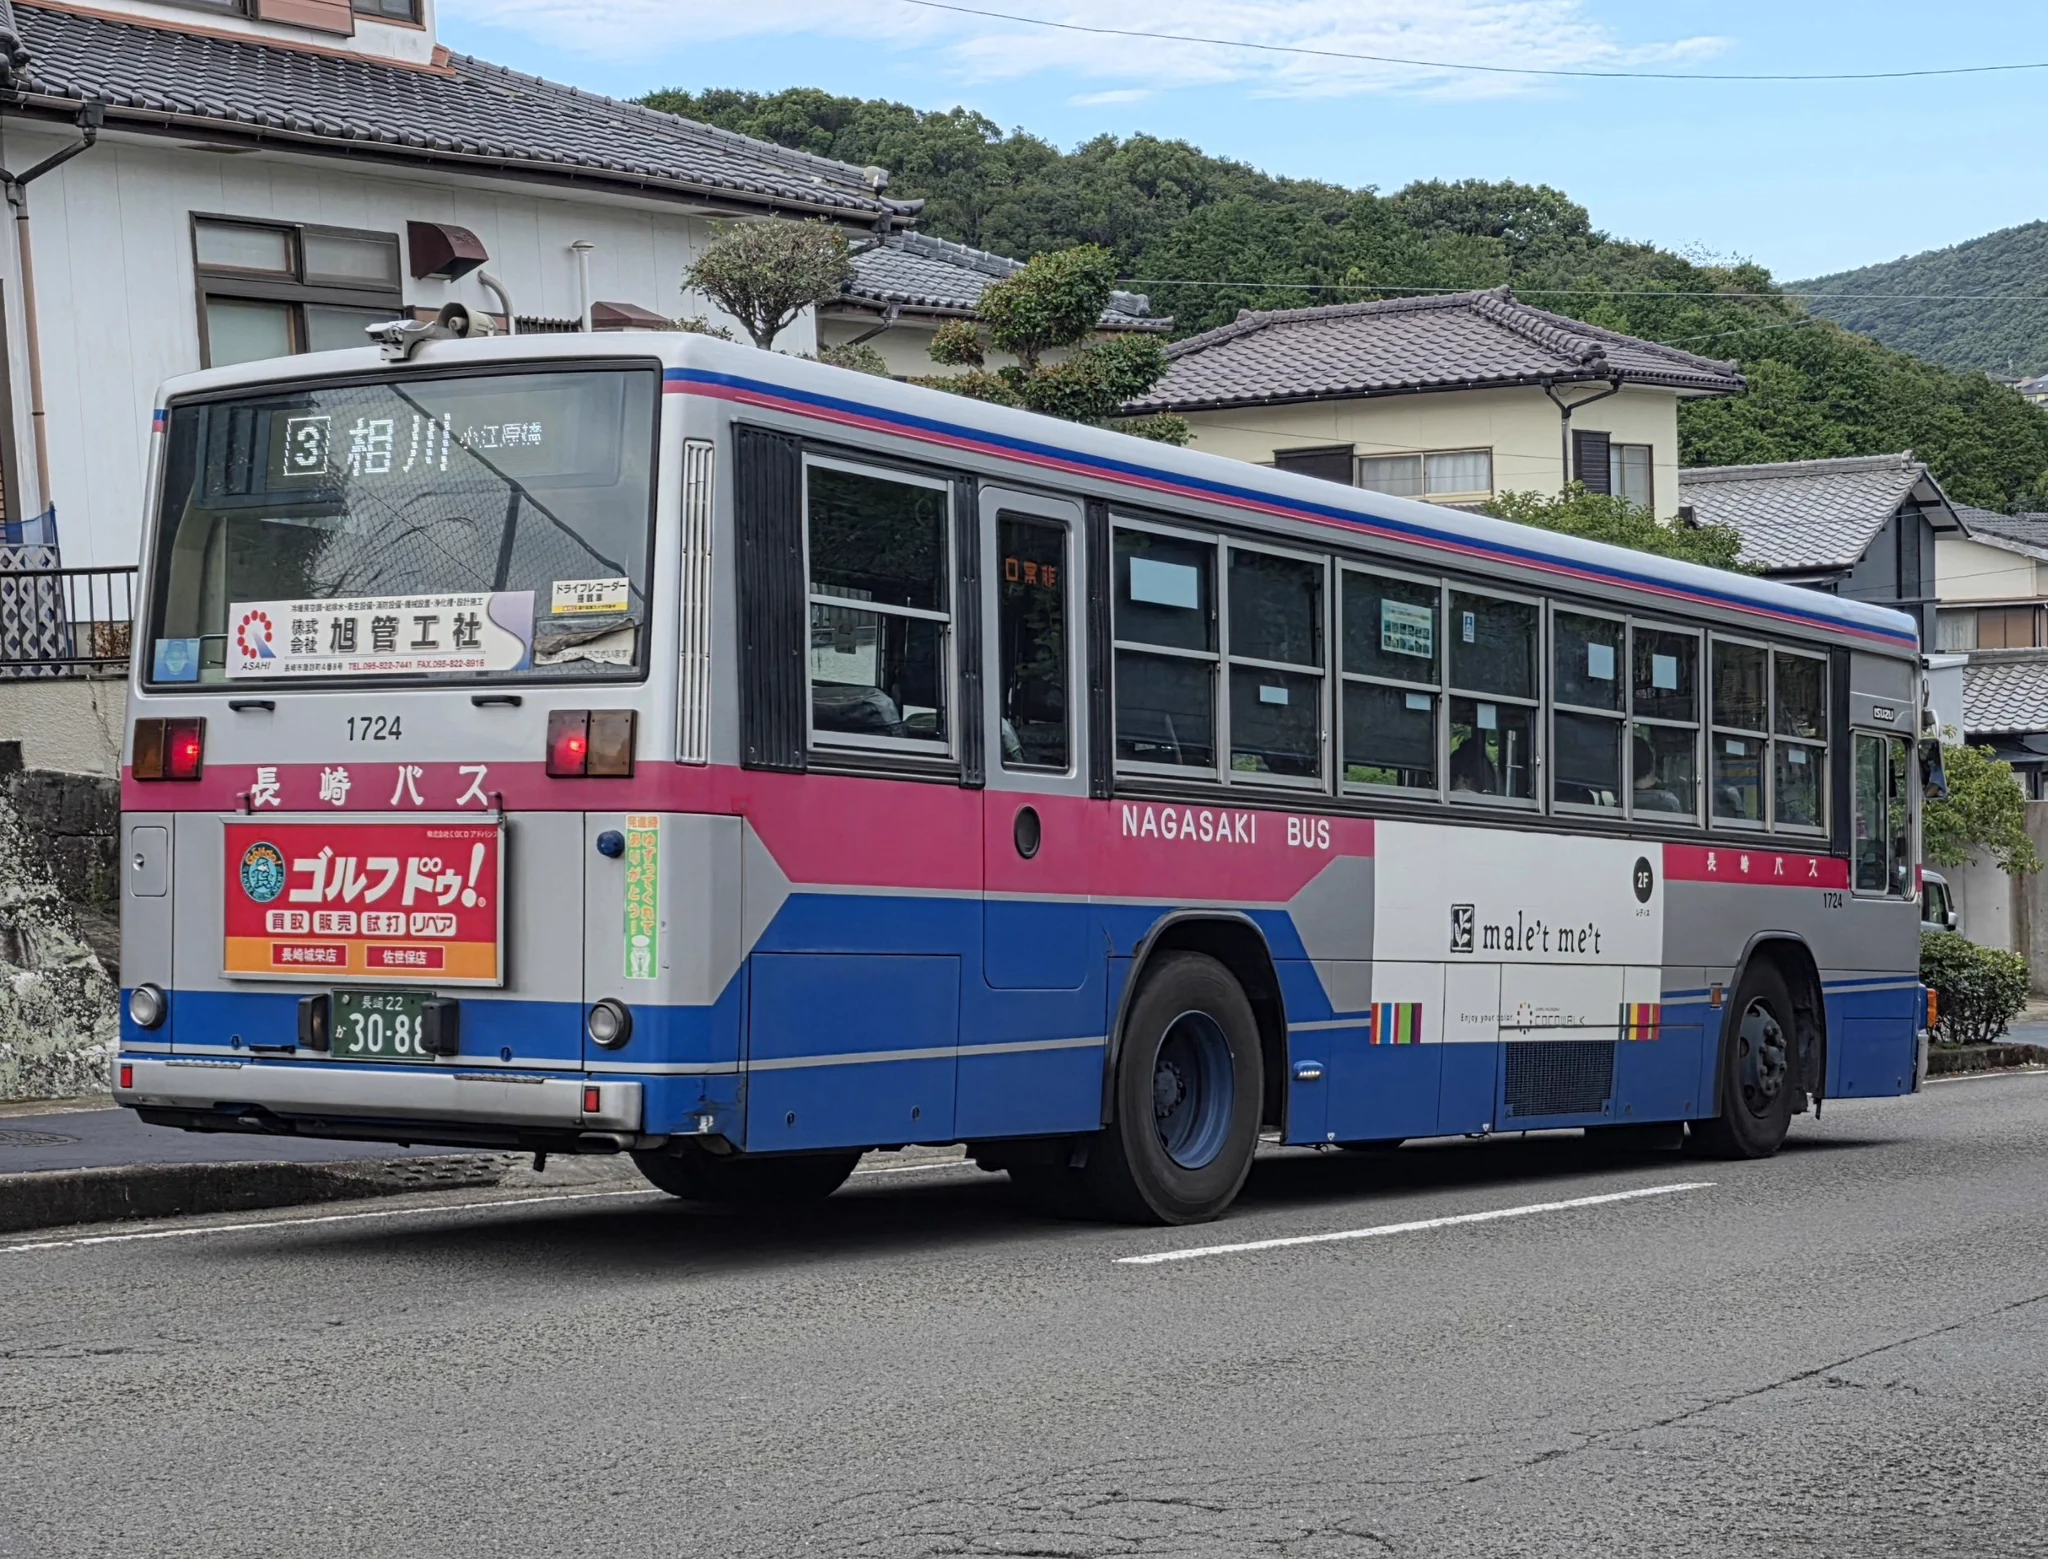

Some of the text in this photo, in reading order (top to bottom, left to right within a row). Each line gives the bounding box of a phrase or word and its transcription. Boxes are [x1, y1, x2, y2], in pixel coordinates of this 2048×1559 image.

[294, 426, 320, 466] 3
[347, 413, 450, 476] 相川
[291, 617, 318, 636] 株式
[329, 612, 483, 652] 旭管工社
[290, 636, 318, 654] 会社
[241, 662, 271, 671] ASAHI
[1874, 707, 1894, 720] ISUZU
[347, 716, 402, 741] 1724
[251, 765, 489, 807] 長崎バス
[1122, 804, 1331, 850] NAGASAKI BUS
[1707, 851, 1818, 878] 長崎バス
[642, 832, 656, 935] ゆずってくれて
[1638, 871, 1649, 888] 2F
[1823, 892, 1843, 909] 1724
[272, 913, 453, 933] 買取 販売 試打 リペア
[282, 948, 428, 965] 長崎城栄店 佐世保店
[1460, 1013, 1478, 1024] Enjoy
[1480, 1015, 1494, 1024] your
